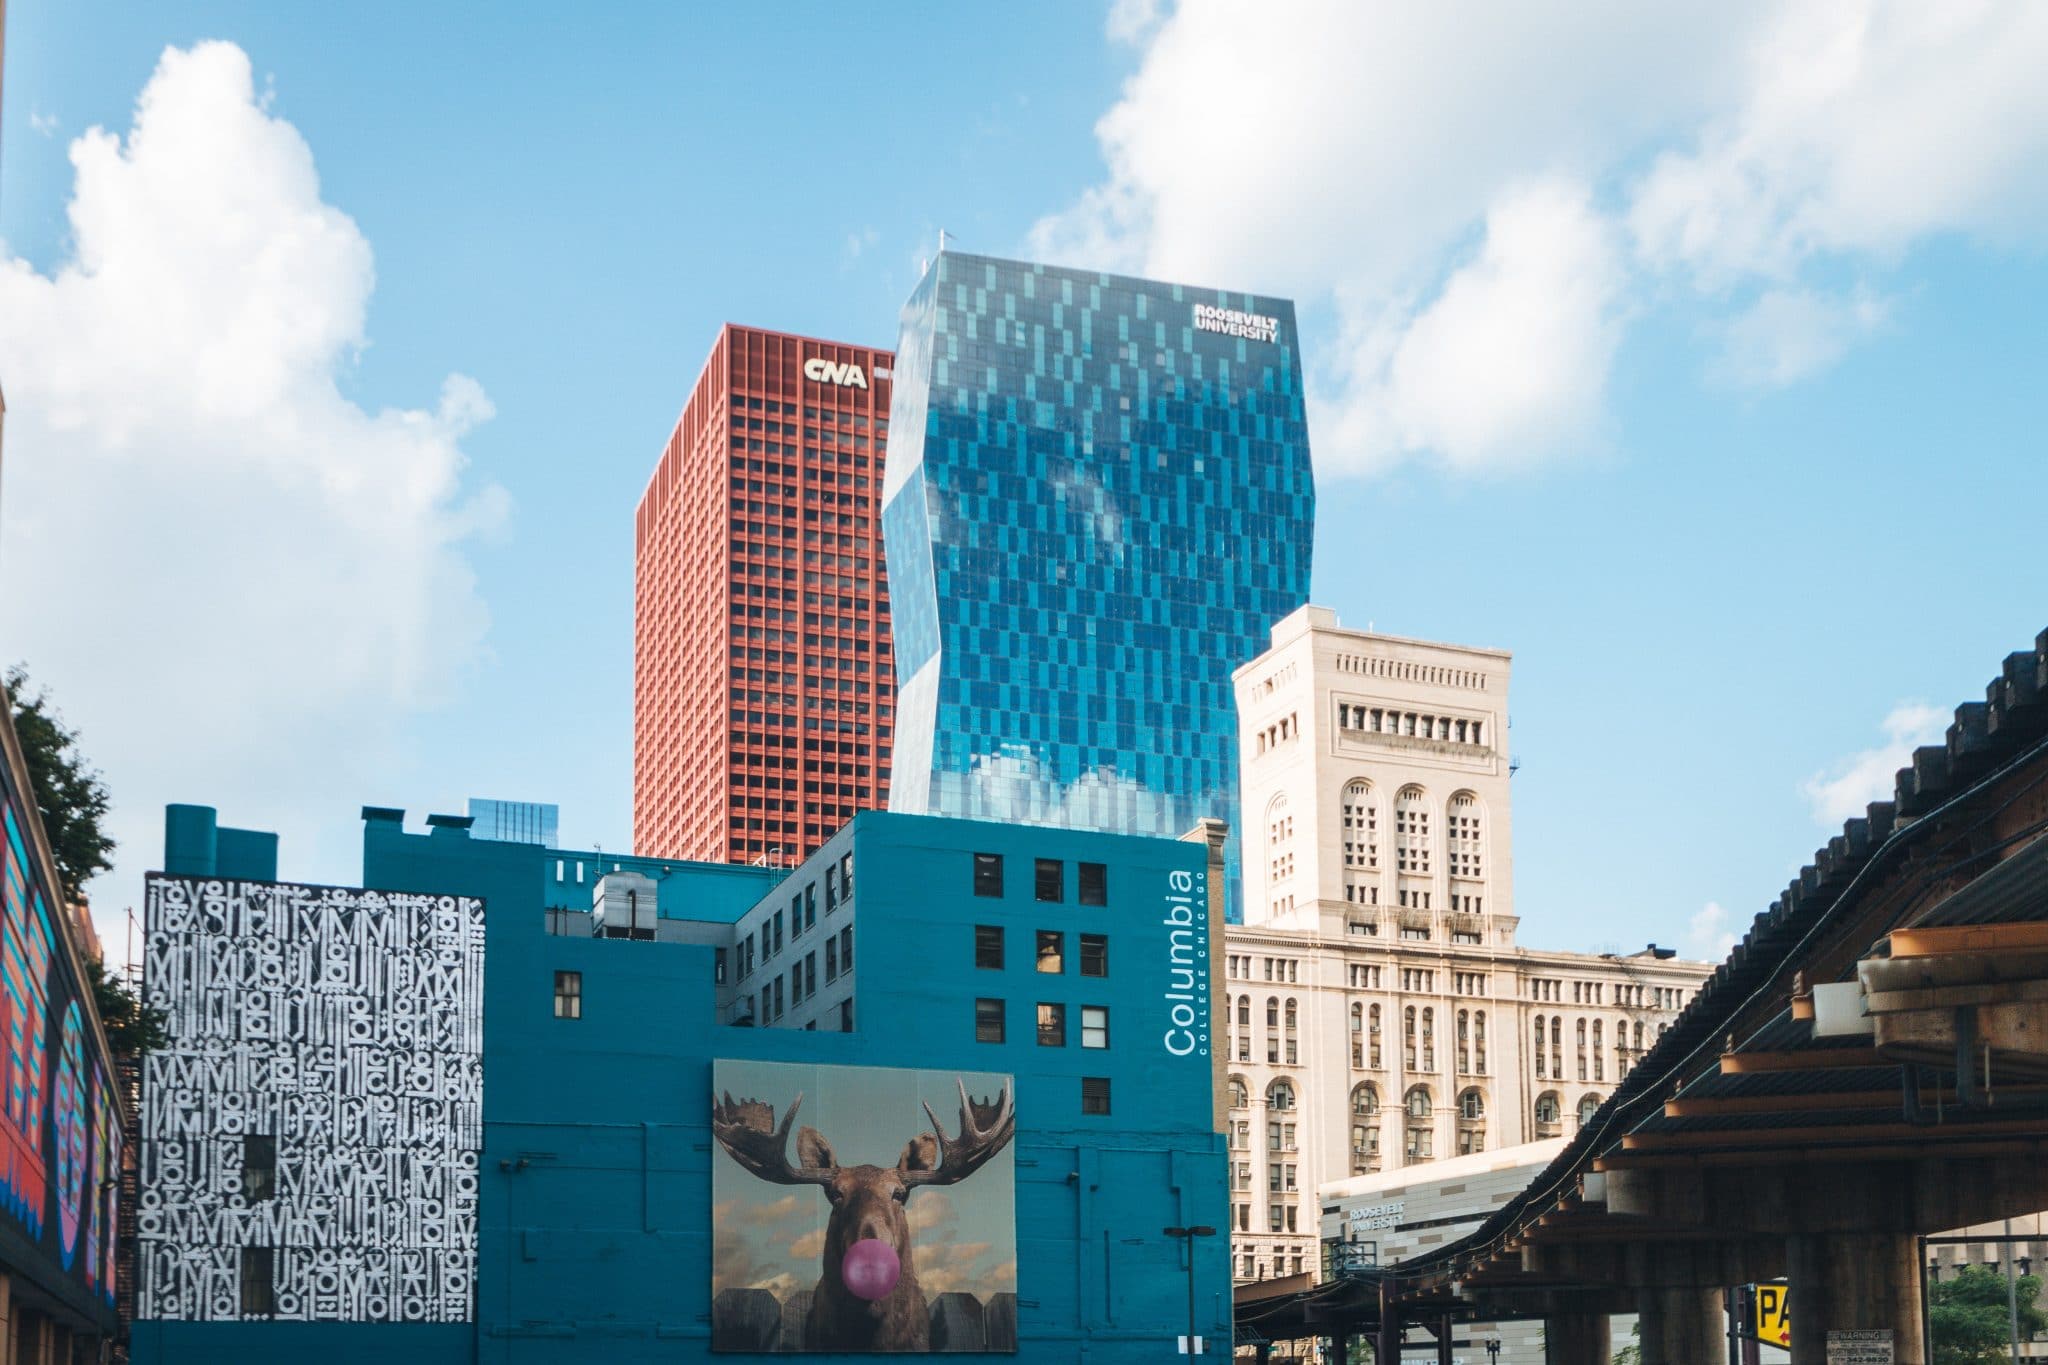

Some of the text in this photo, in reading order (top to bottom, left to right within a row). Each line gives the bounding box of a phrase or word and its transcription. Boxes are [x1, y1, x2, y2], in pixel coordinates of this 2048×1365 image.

[1194, 303, 1278, 330] ROOSEVELT
[1195, 317, 1278, 344] UNIVERSITY
[804, 358, 868, 389] CNA
[1163, 870, 1196, 1056] Columbia
[1196, 872, 1208, 1056] COLLEGE CHICAGO
[1350, 1201, 1405, 1220] ROOSEVELT
[1840, 1331, 1880, 1340] WARNING
